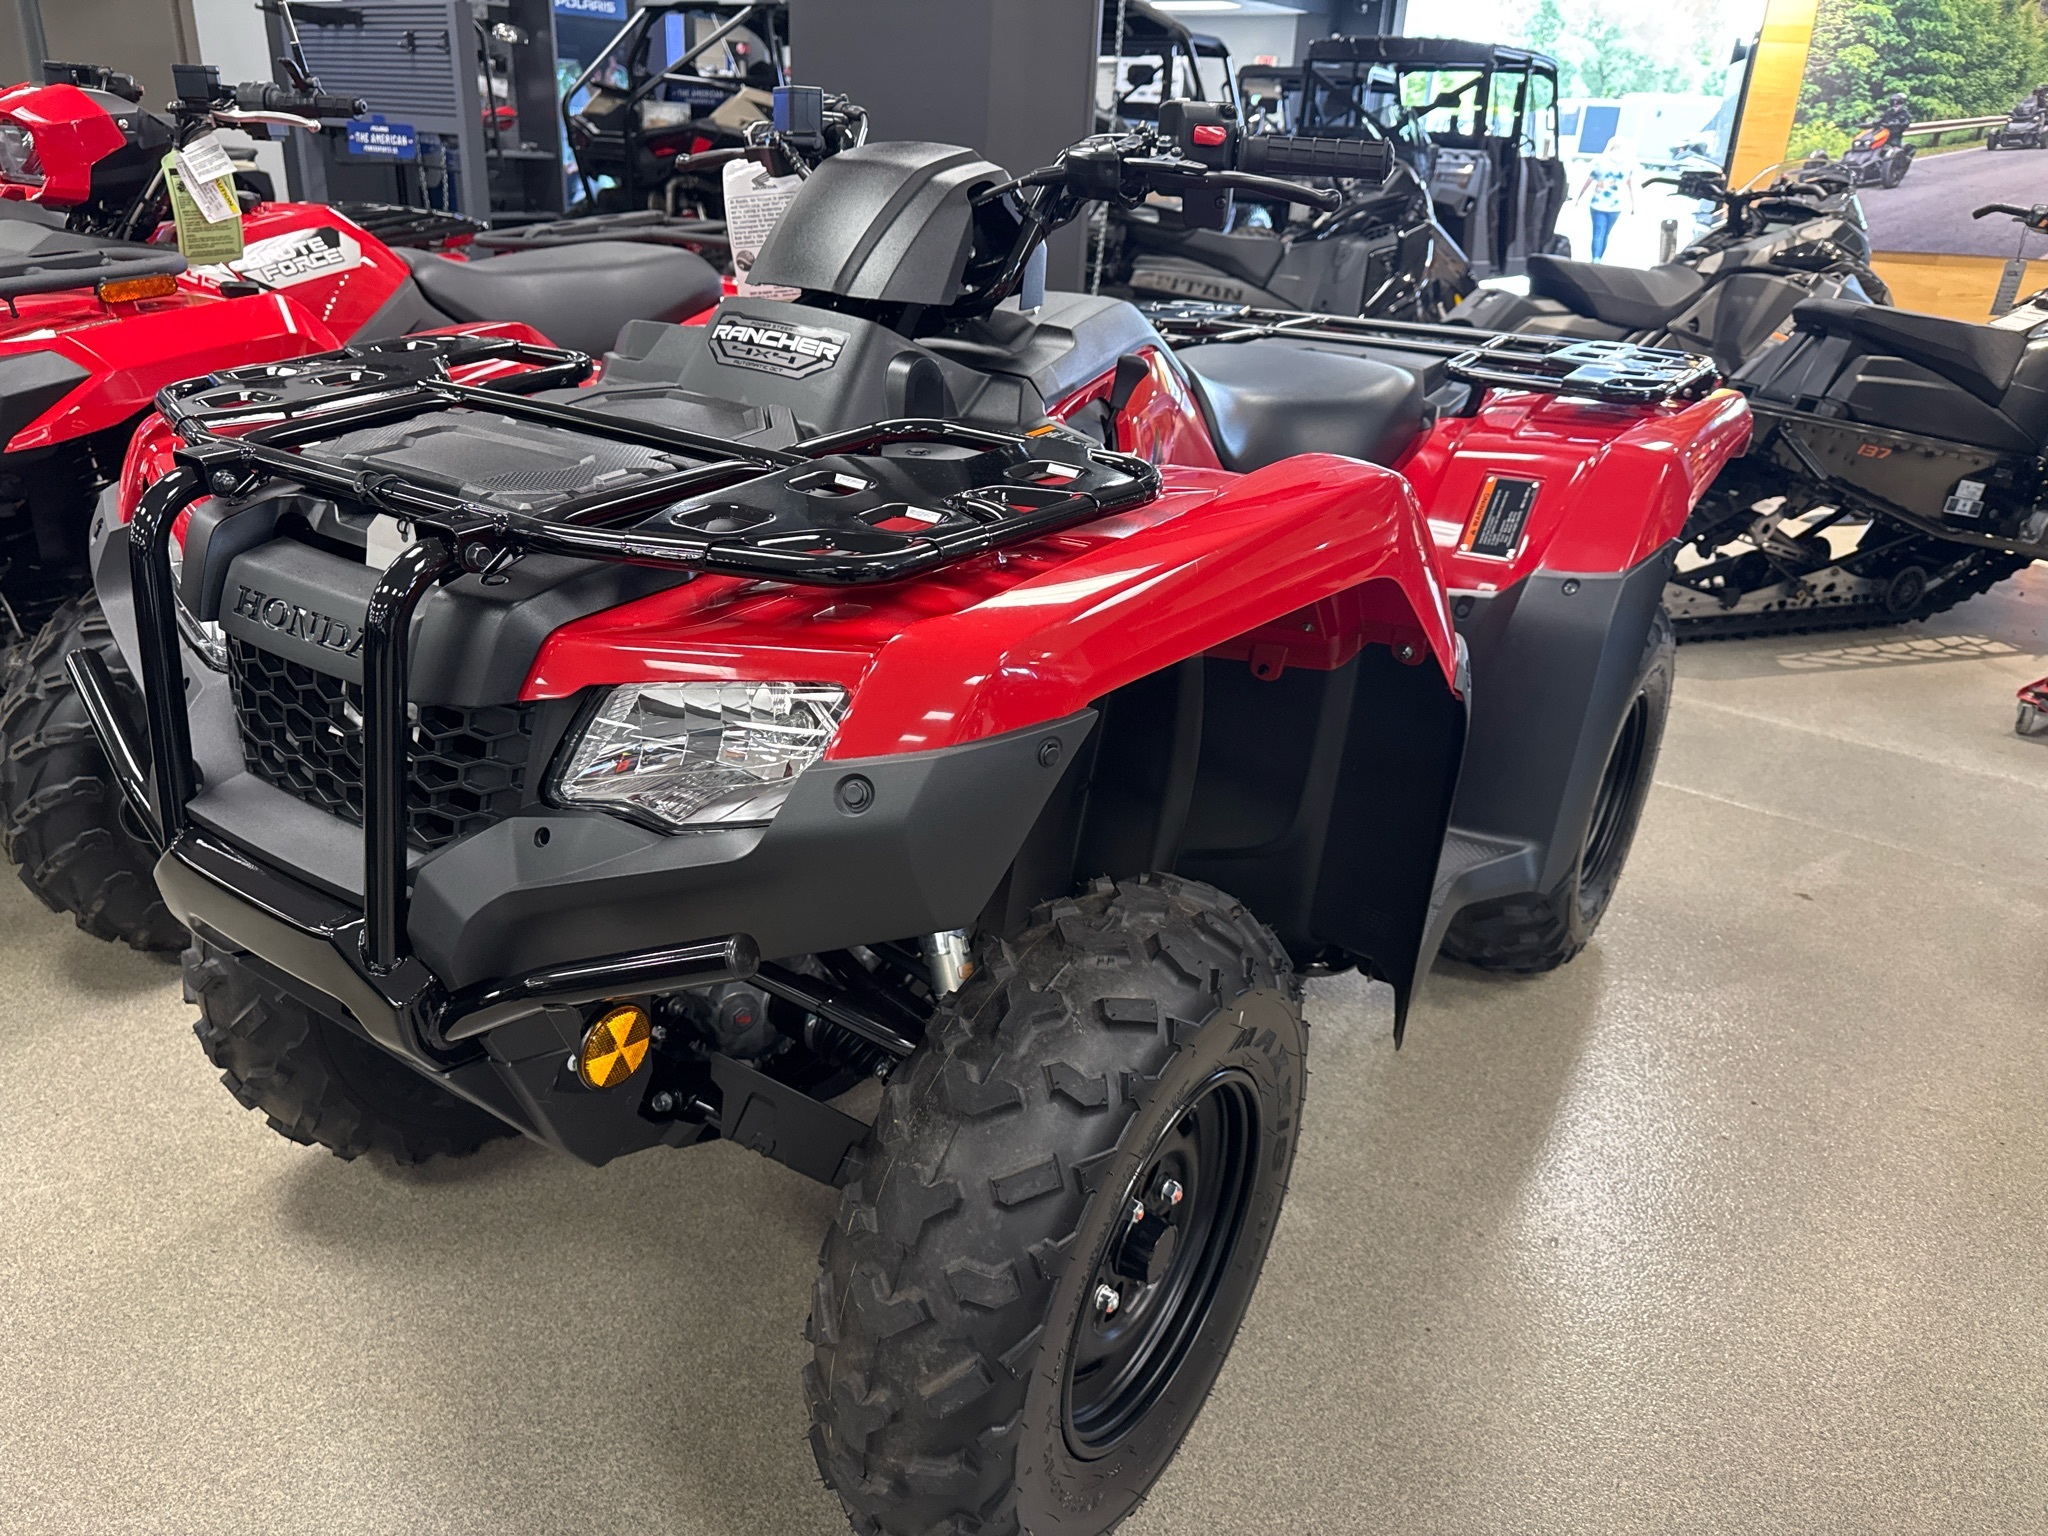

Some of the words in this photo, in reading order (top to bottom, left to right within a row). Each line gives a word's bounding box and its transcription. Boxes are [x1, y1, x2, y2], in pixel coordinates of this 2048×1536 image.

[355, 131, 369, 143] THE
[370, 133, 408, 146] AMERICAN
[261, 247, 345, 283] FORCE
[751, 321, 771, 329] POWER
[712, 324, 841, 361] RANCHER
[733, 360, 768, 371] AUTOMATIC
[1857, 443, 1892, 459] 137
[1473, 492, 1490, 526] WARNING
